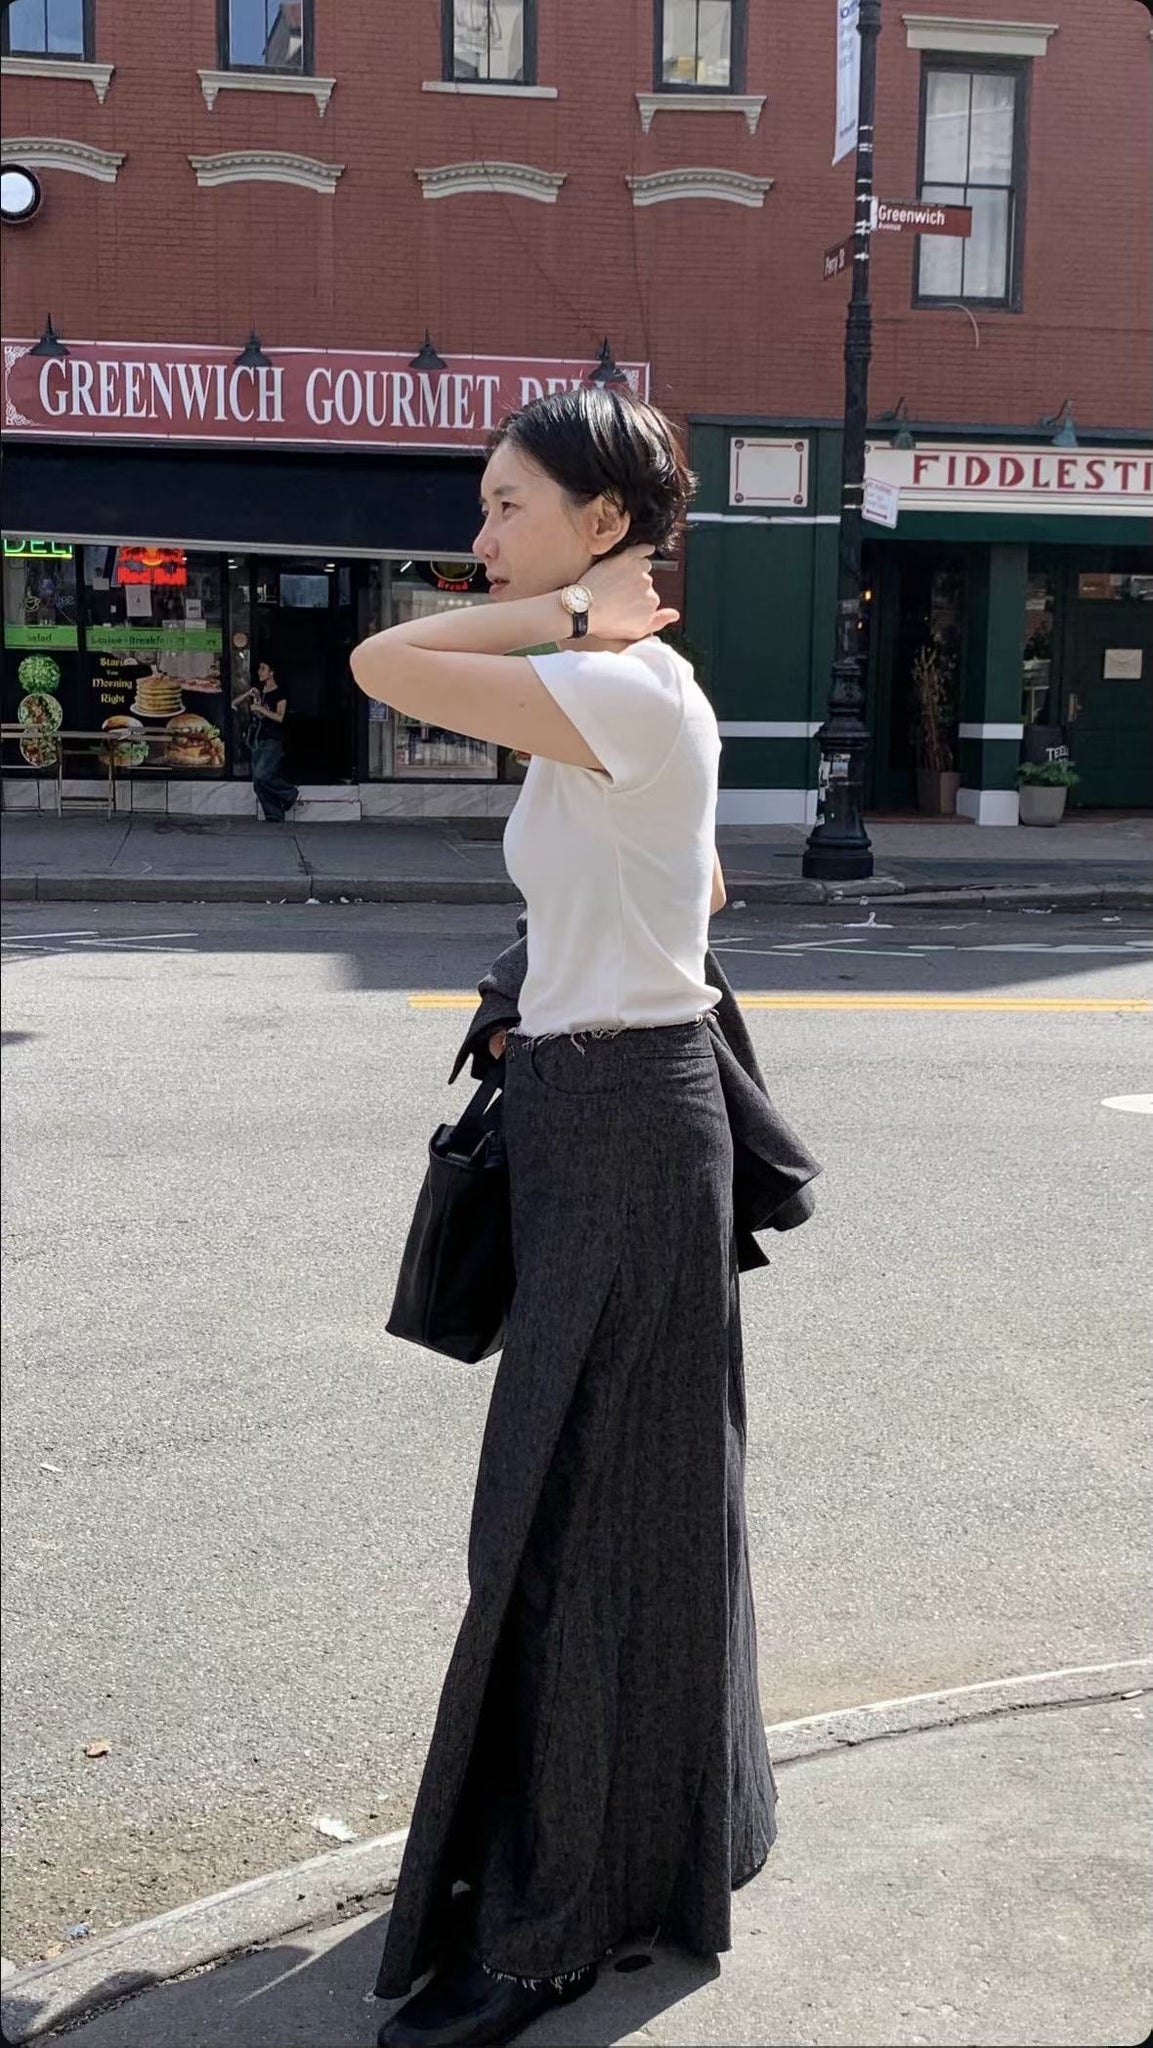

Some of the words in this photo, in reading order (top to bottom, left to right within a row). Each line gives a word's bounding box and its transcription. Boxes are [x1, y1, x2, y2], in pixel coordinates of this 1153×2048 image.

[878, 204, 946, 226] Greenwich
[39, 358, 285, 422] GREENWICH
[305, 367, 500, 430] GOURMET
[912, 454, 1152, 491] FIDDLESTI
[92, 678, 133, 689] Morning
[100, 693, 125, 704] Right
